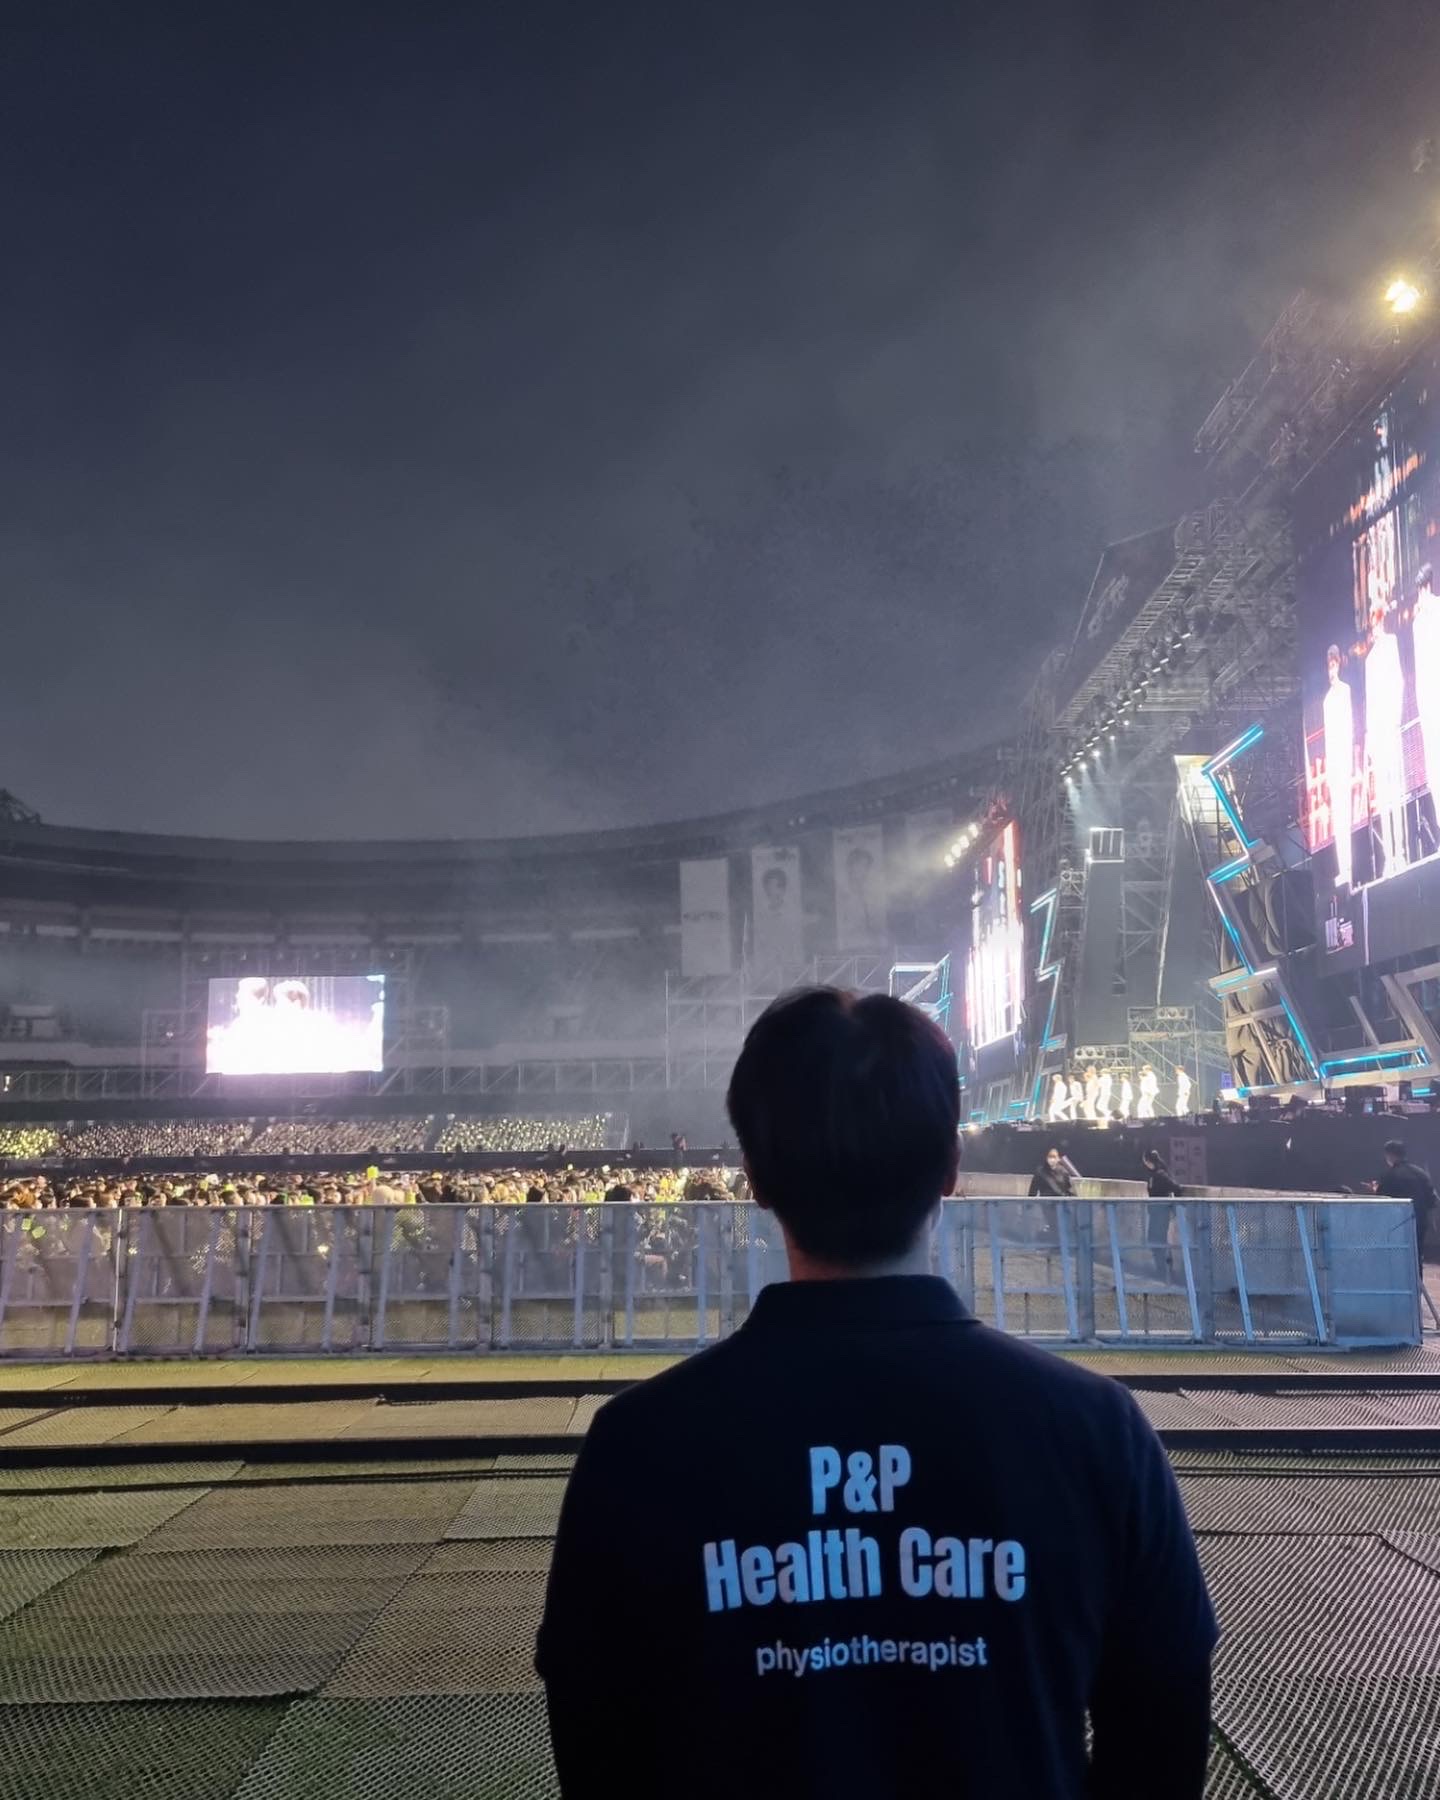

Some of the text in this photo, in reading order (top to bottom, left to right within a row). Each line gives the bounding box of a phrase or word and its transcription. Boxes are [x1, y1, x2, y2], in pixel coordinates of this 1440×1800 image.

[809, 1445, 911, 1514] P&P
[703, 1527, 1027, 1612] Health Care
[756, 1635, 988, 1677] physiotherapist
